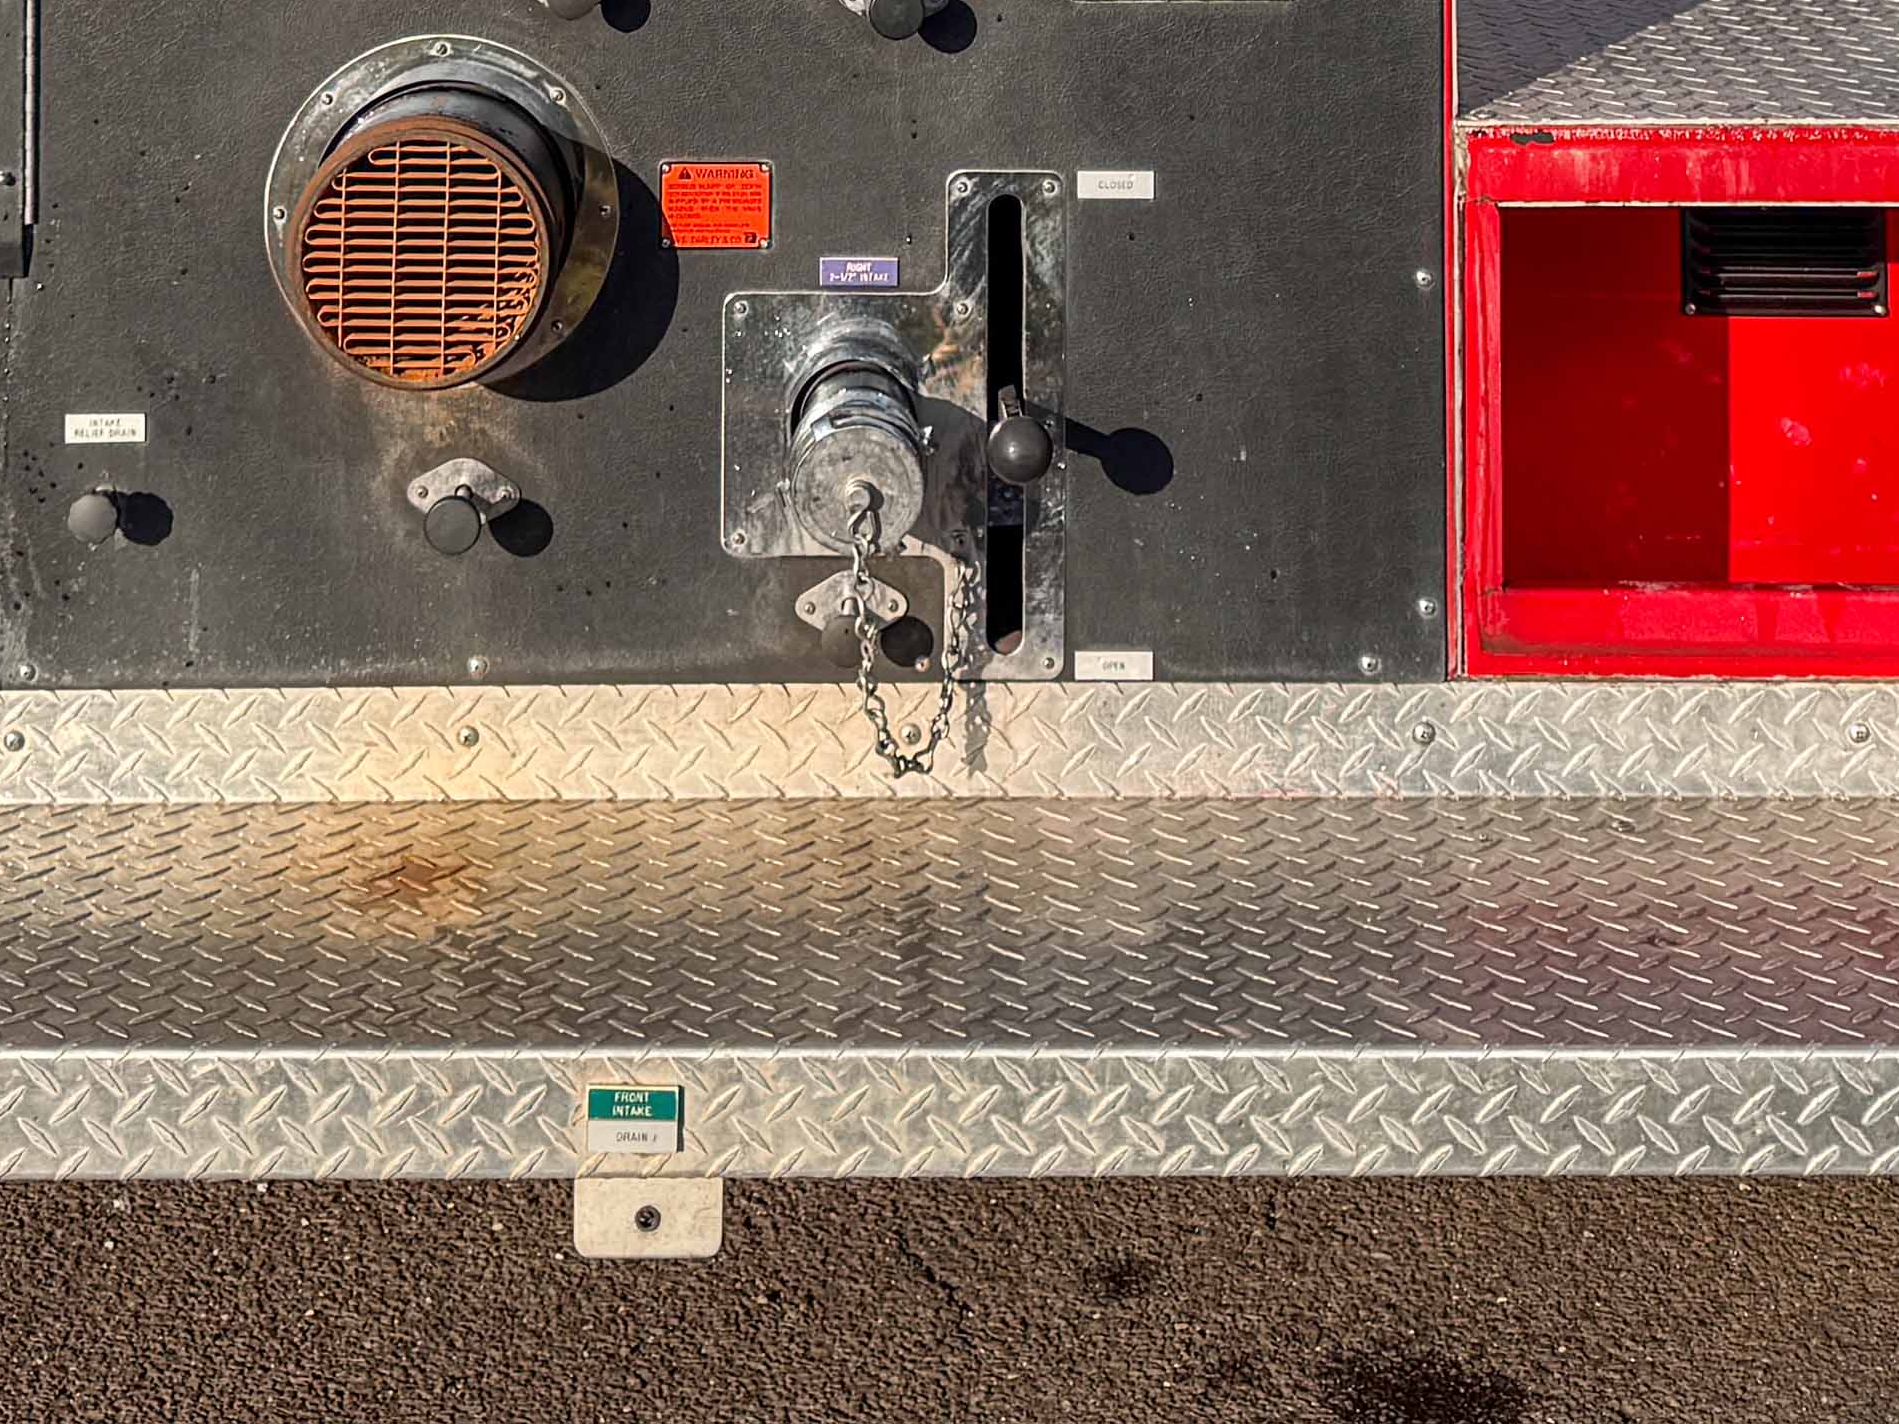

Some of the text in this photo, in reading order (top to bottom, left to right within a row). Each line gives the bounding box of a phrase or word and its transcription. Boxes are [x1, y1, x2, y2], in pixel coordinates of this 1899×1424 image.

[695, 168, 754, 179] WARNING
[1098, 180, 1134, 190] CLOSED
[846, 262, 872, 272] RIGHT
[859, 272, 888, 282] INTAKE
[614, 1091, 651, 1103] FRONT
[612, 1105, 653, 1117] INTAKE
[616, 1131, 649, 1143] DRAIN
